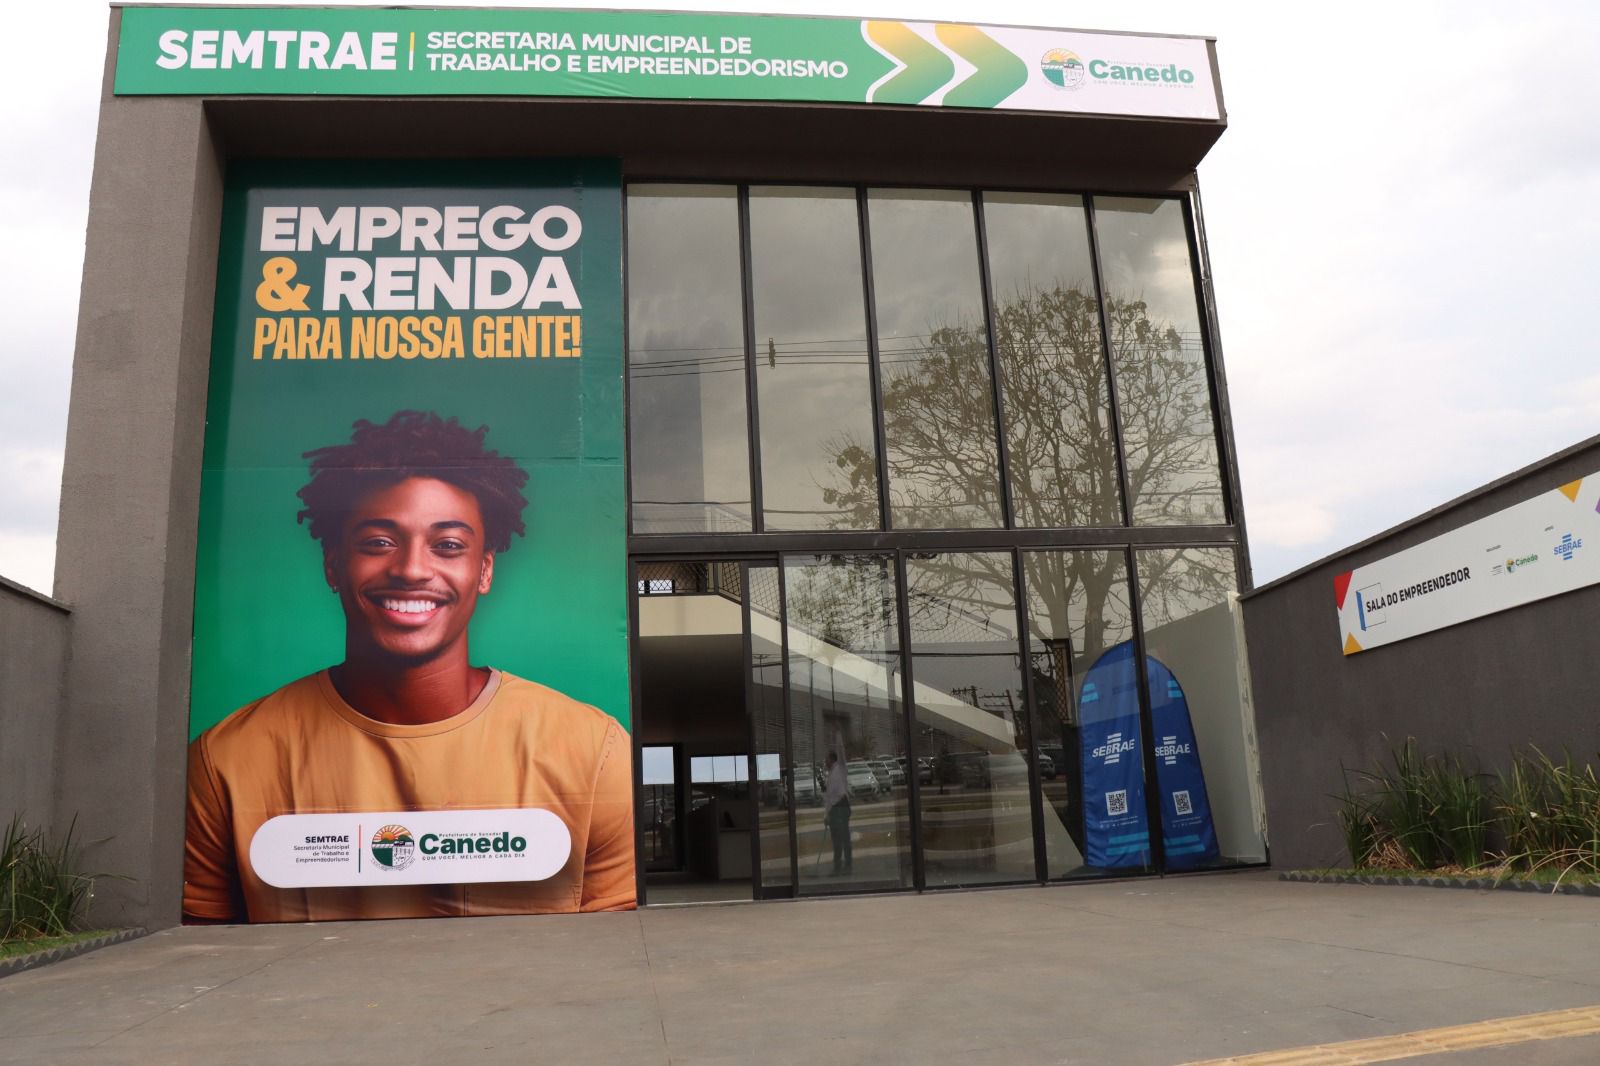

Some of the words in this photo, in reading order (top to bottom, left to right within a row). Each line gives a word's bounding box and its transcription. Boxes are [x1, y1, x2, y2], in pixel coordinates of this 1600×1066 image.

[155, 29, 398, 71] SEMTRAE
[426, 31, 577, 51] SECRETARIA
[582, 33, 715, 54] MUNICIPAL
[720, 37, 752, 55] DE
[426, 53, 562, 72] TRABALHO
[567, 55, 582, 73] E
[587, 55, 849, 79] EMPREENDEDORISMO
[1088, 59, 1194, 84] Canedo
[260, 205, 583, 252] EMPREGO
[255, 256, 311, 312] &
[322, 256, 583, 311] RENDA
[253, 317, 343, 360] PARA
[350, 316, 465, 360] NOSSA
[472, 315, 581, 359] GENTE!
[1553, 538, 1582, 555] SEBRAE
[1515, 554, 1538, 566] Canedo
[1366, 596, 1387, 613] SALA
[1386, 592, 1399, 606] DO
[1399, 566, 1471, 602] EMPREENDEDOR
[1092, 739, 1136, 758] SEBRAE
[1154, 743, 1191, 757] SEBRAE
[305, 835, 349, 844] SEMTRAE
[419, 831, 527, 855] Canedo
